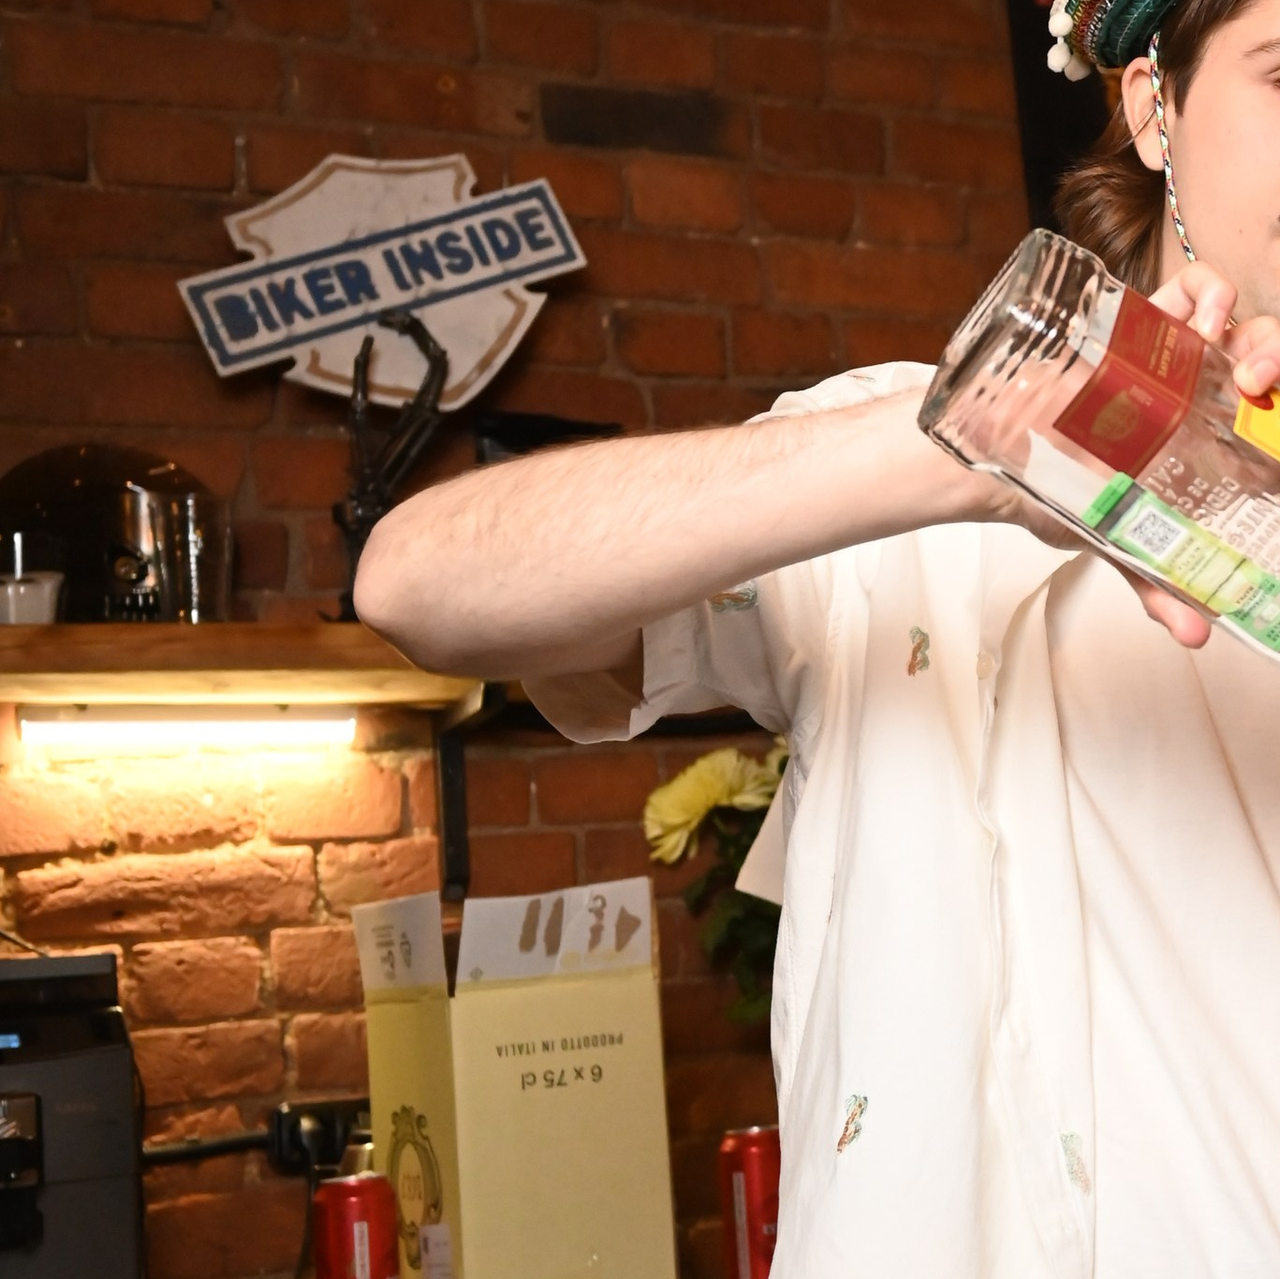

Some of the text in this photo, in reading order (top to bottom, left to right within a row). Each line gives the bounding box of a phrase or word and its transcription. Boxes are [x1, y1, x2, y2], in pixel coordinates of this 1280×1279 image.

[212, 206, 555, 342] BIKER INSIDE
[495, 1033, 624, 1057] PRODOTTO IN ITALIA
[521, 1064, 603, 1091] 6 x 75 cl
